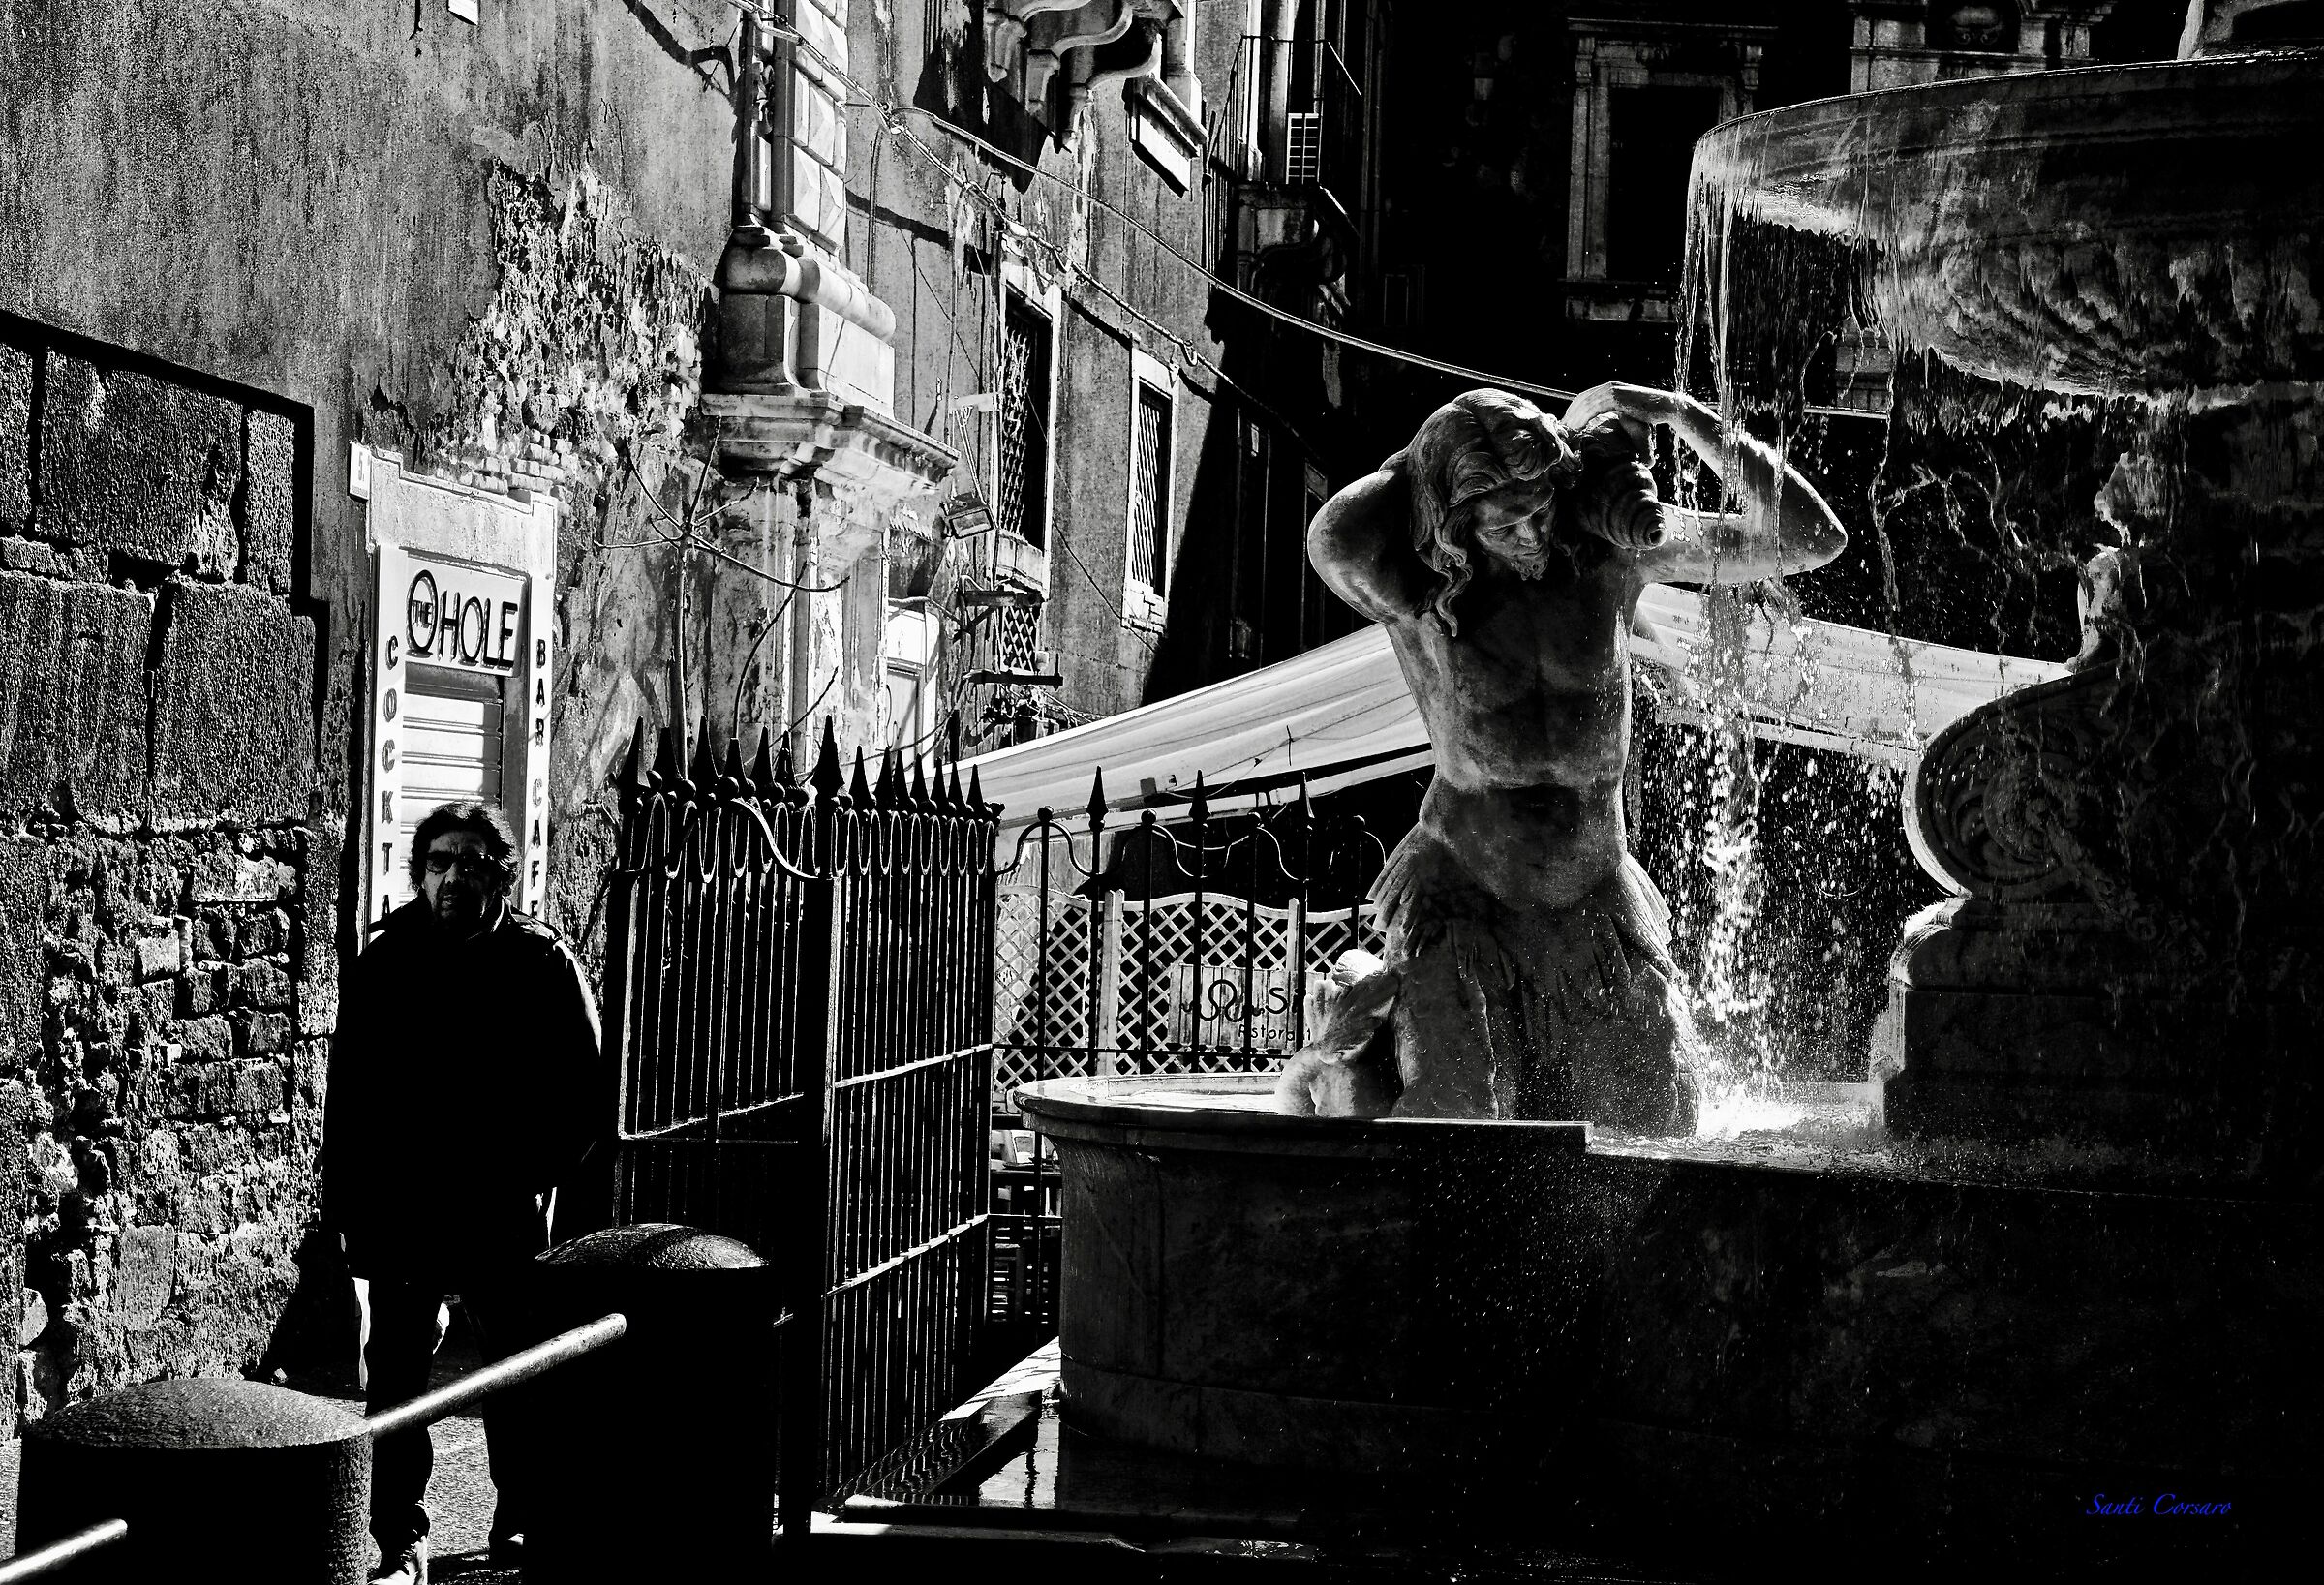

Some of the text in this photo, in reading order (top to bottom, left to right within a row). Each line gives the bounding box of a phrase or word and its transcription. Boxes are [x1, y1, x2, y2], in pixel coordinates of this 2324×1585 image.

[411, 590, 518, 671] THE HOLE
[535, 638, 546, 745] BAR
